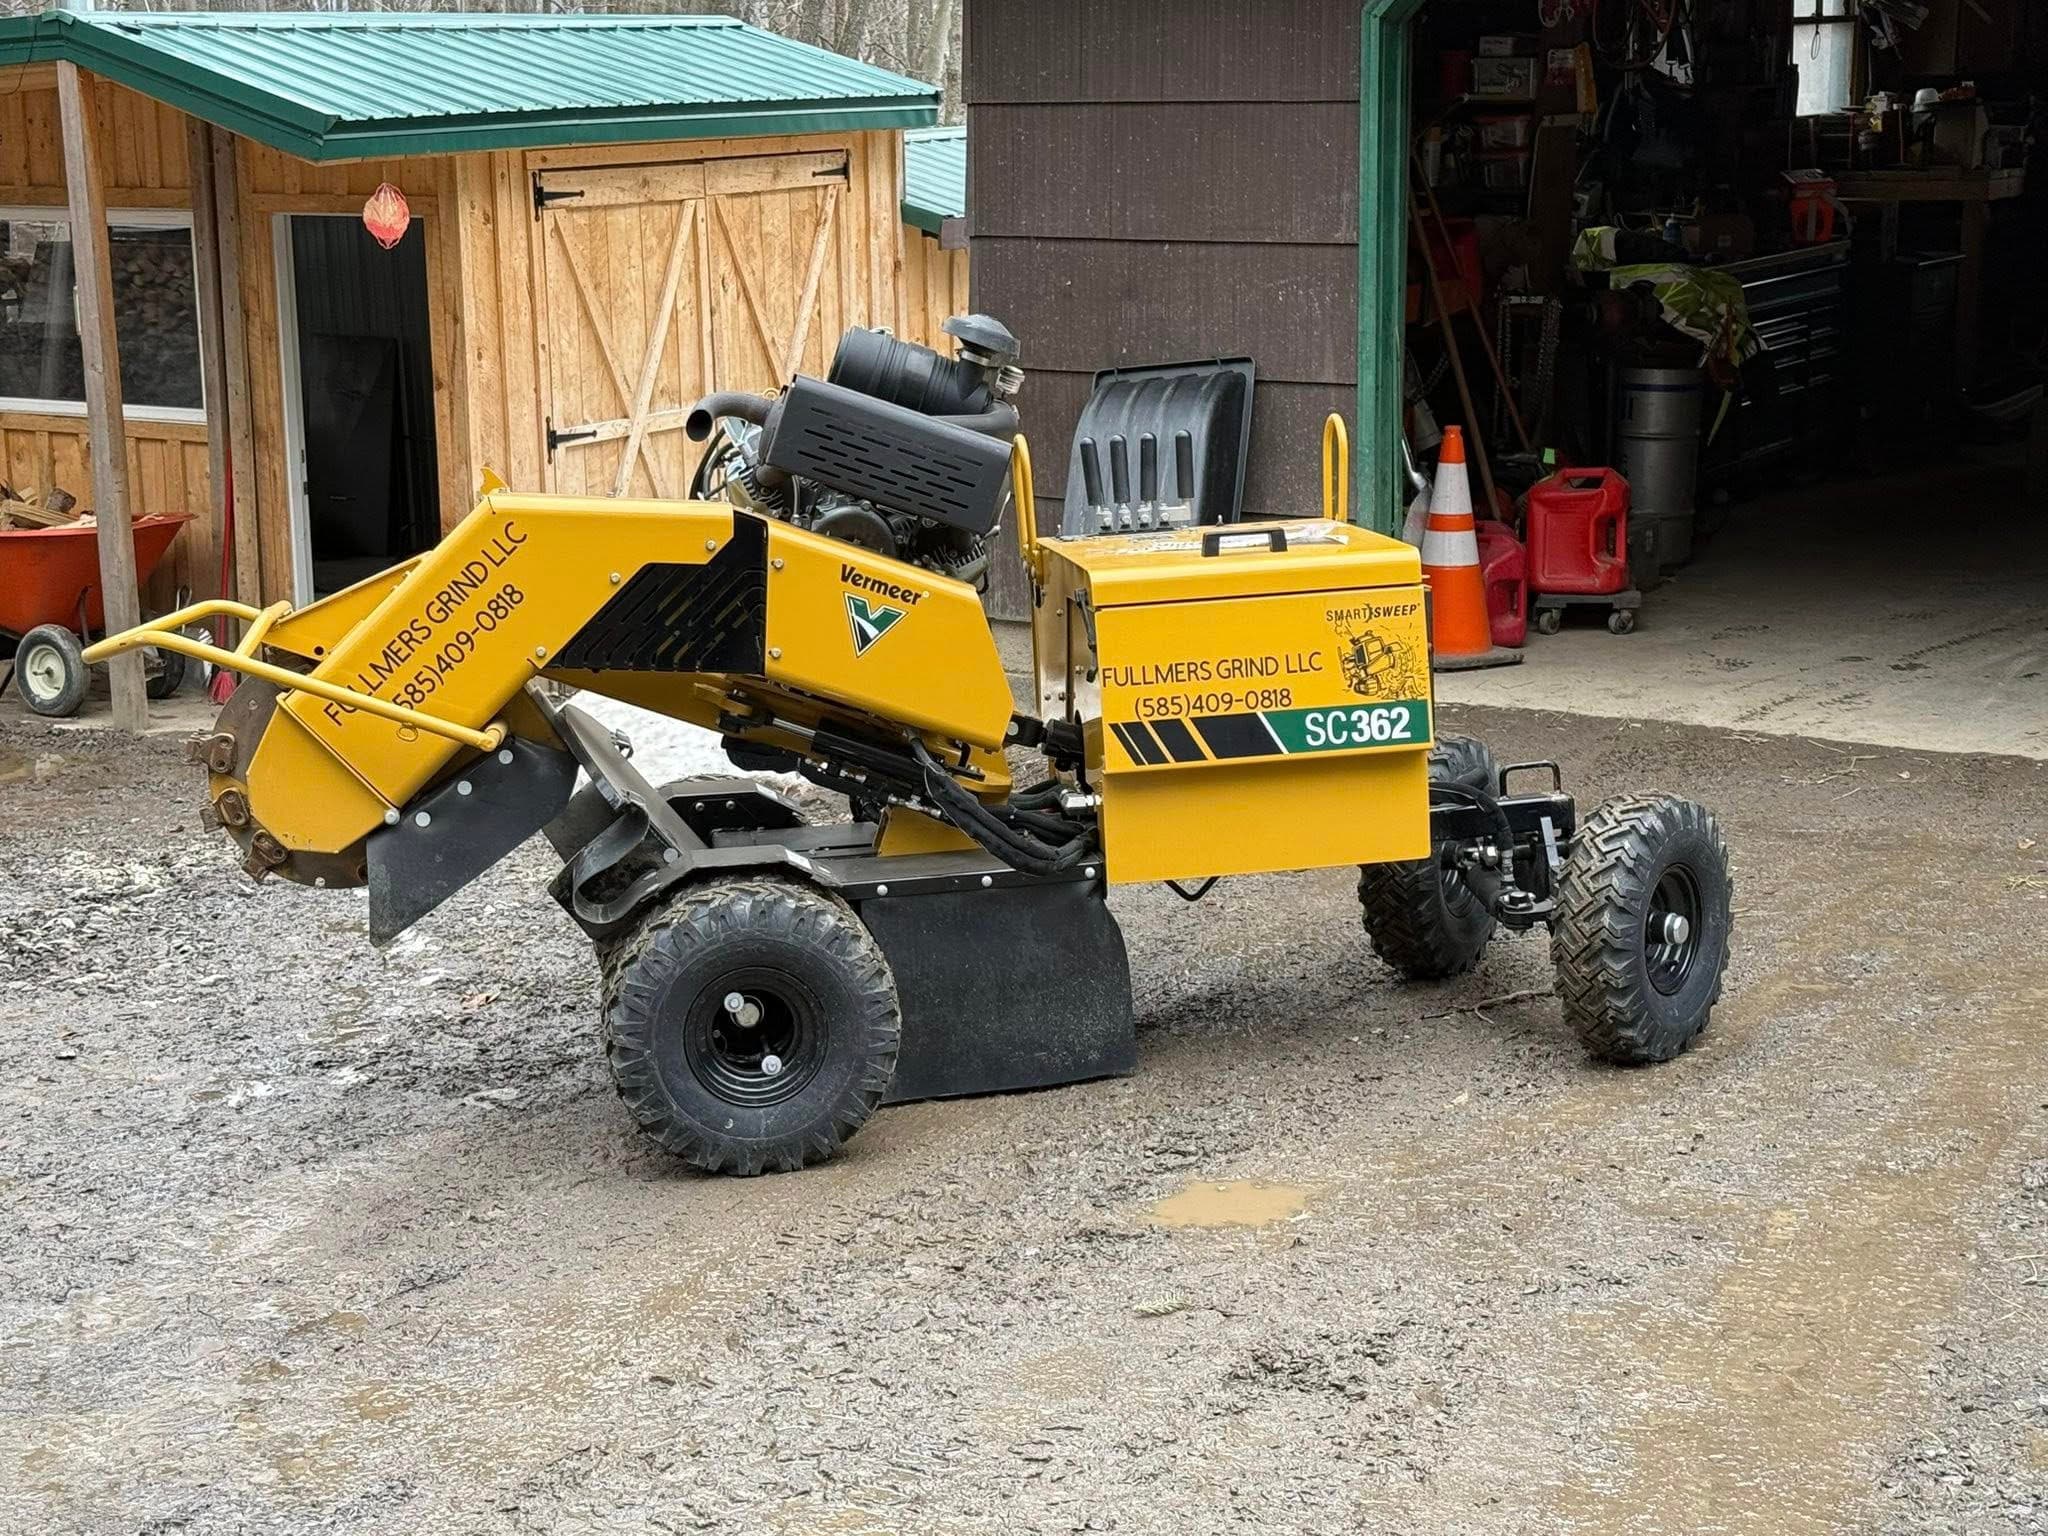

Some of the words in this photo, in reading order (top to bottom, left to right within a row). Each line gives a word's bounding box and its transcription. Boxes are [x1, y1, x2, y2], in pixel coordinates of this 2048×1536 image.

[426, 561, 489, 624] GRIND
[481, 521, 528, 568] LLC
[840, 563, 922, 606] Vermeer
[1326, 607, 1368, 622] SMART
[1373, 603, 1418, 618] SWEEP
[391, 583, 525, 712] 585)409-0818
[1102, 660, 1213, 688] FULLMERS
[1216, 656, 1280, 680] GRIND
[1285, 651, 1324, 674] LLC
[1134, 688, 1293, 721] (585)409-0818
[1304, 706, 1412, 747] SC362
